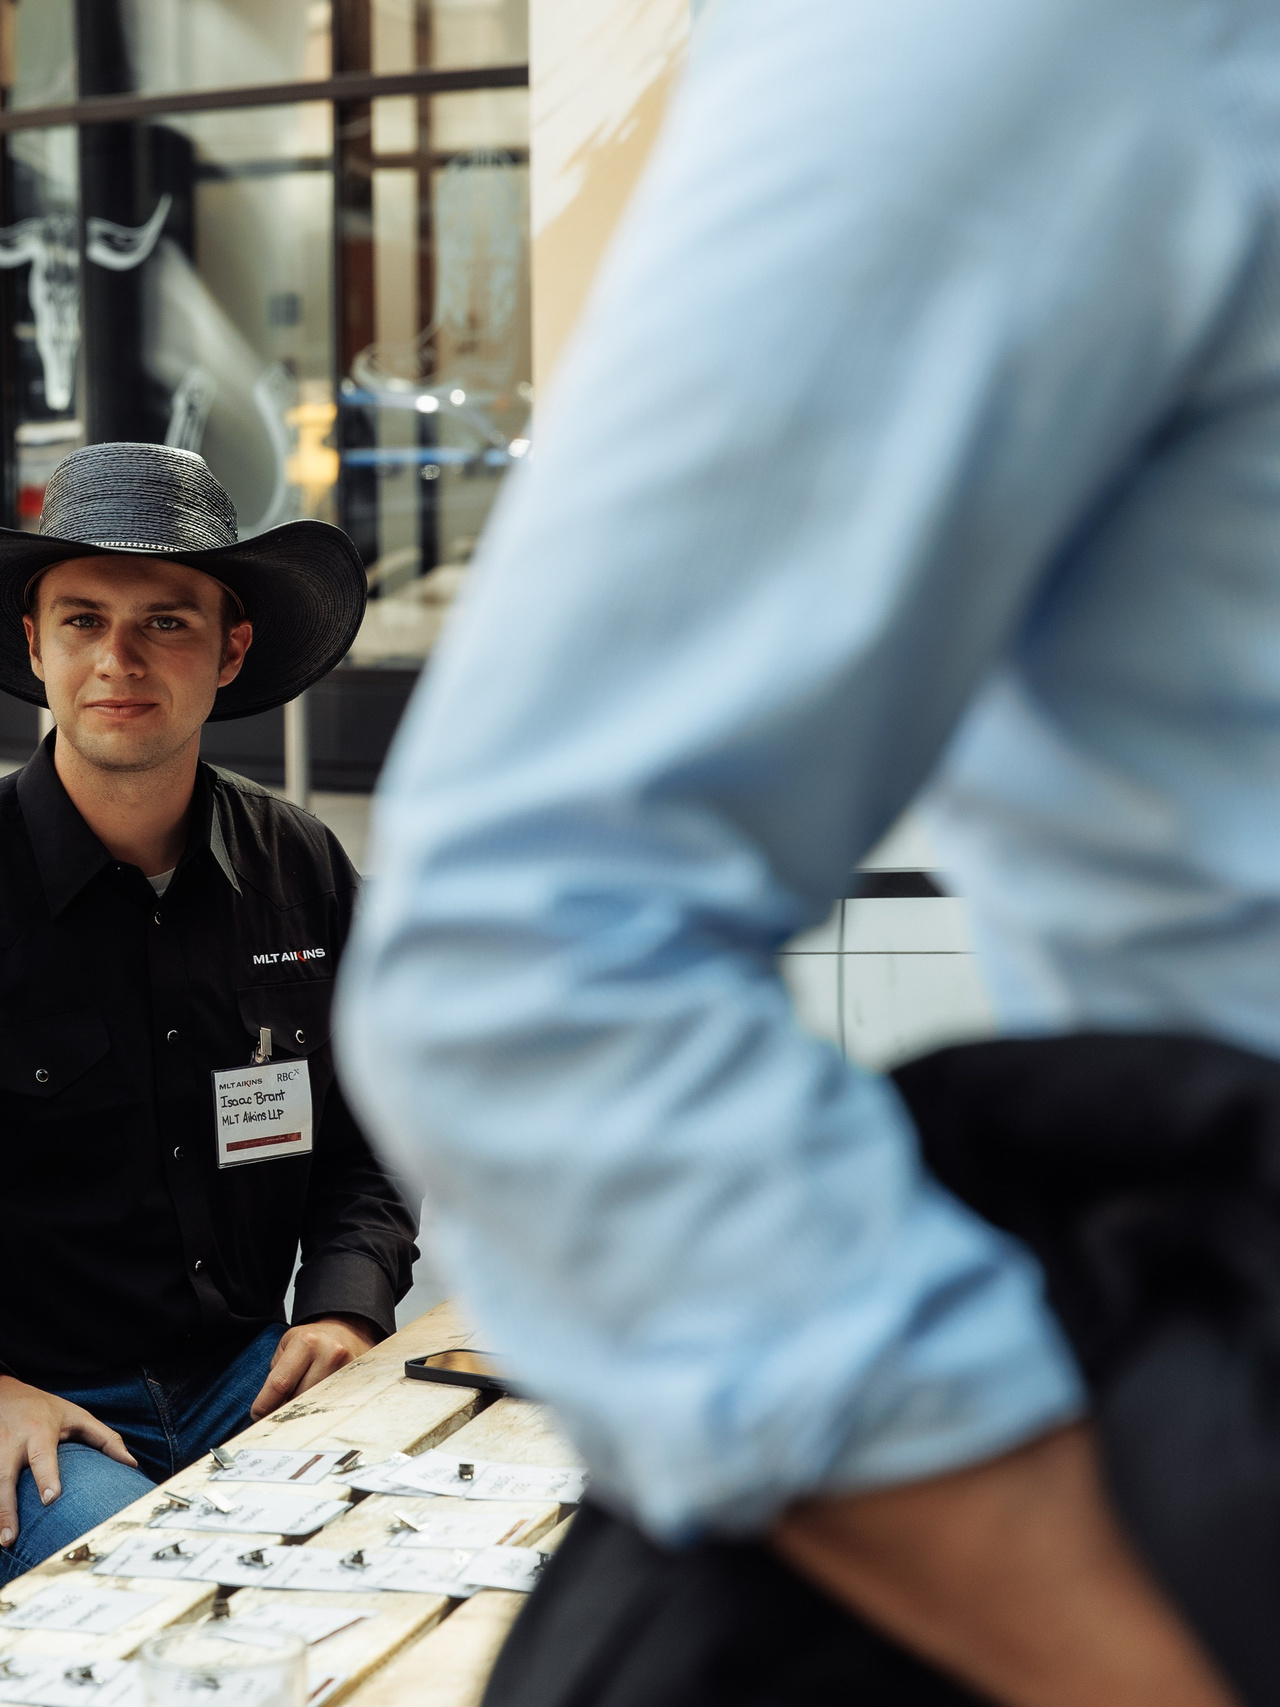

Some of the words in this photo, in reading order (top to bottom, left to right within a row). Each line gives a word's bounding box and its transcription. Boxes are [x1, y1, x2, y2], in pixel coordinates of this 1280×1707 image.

[253, 953, 280, 965] MLT
[281, 948, 326, 962] AIKINS
[219, 1082, 236, 1090] MLT
[236, 1078, 263, 1088] AIKINS
[220, 1095, 253, 1108] Isaac
[254, 1089, 286, 1105] Brant
[222, 1114, 240, 1126] MLT
[243, 1111, 267, 1123] Aikins
[268, 1109, 284, 1120] LLP
